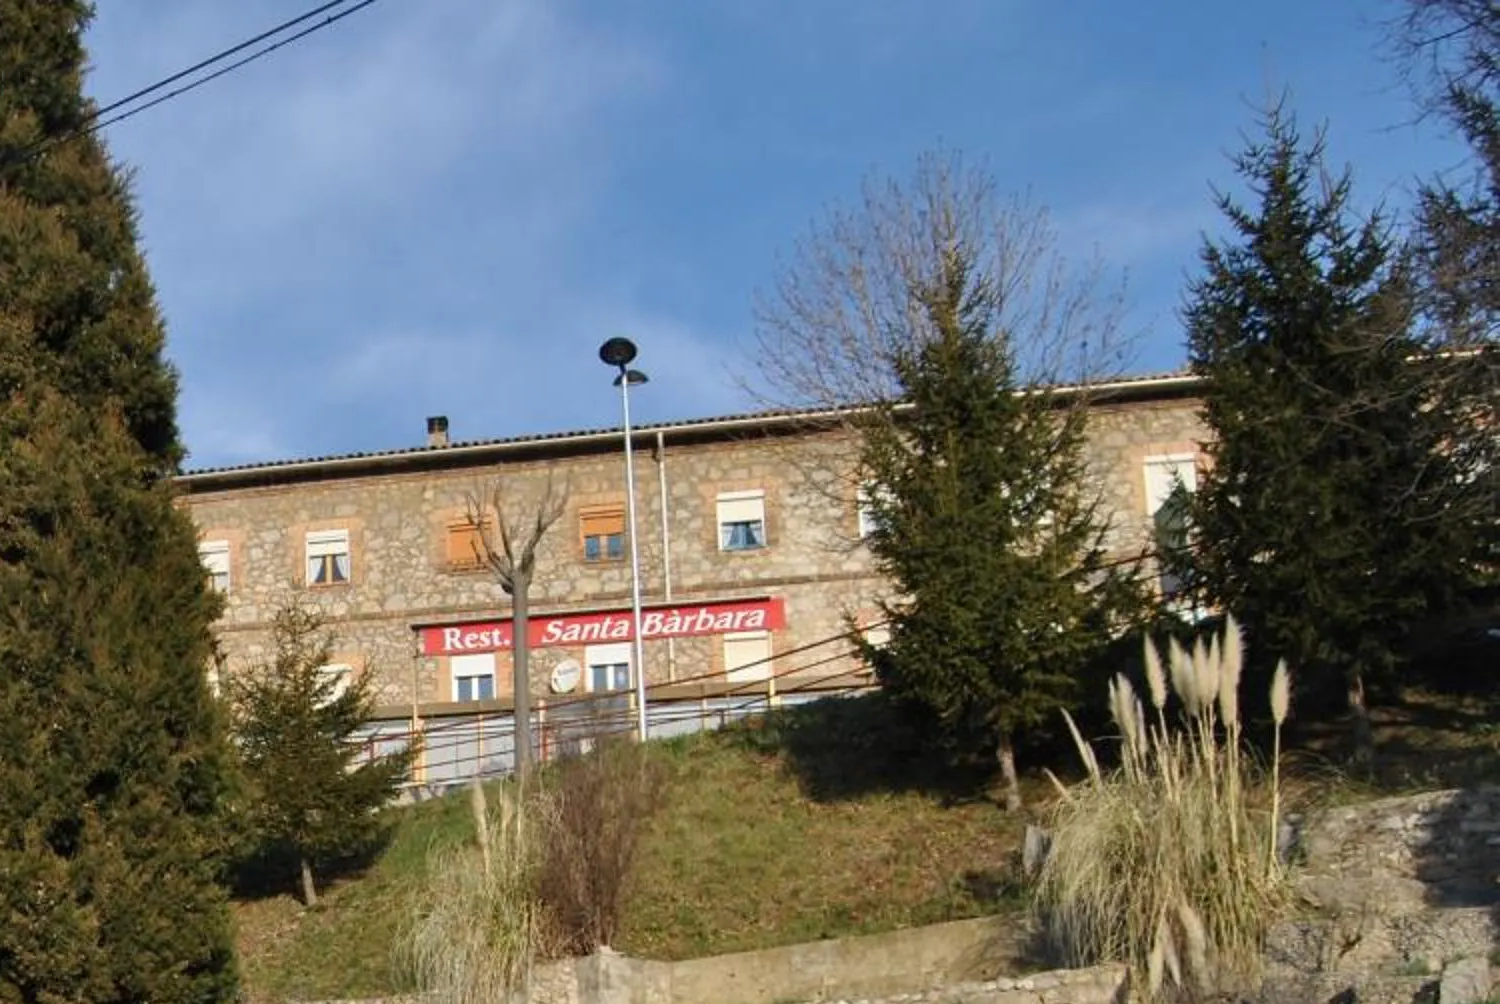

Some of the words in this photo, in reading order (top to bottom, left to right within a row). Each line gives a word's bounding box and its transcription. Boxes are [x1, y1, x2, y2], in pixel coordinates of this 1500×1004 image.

[443, 627, 511, 651] Rest.
[541, 615, 631, 644] Santa
[641, 607, 765, 635] Bàrbara
